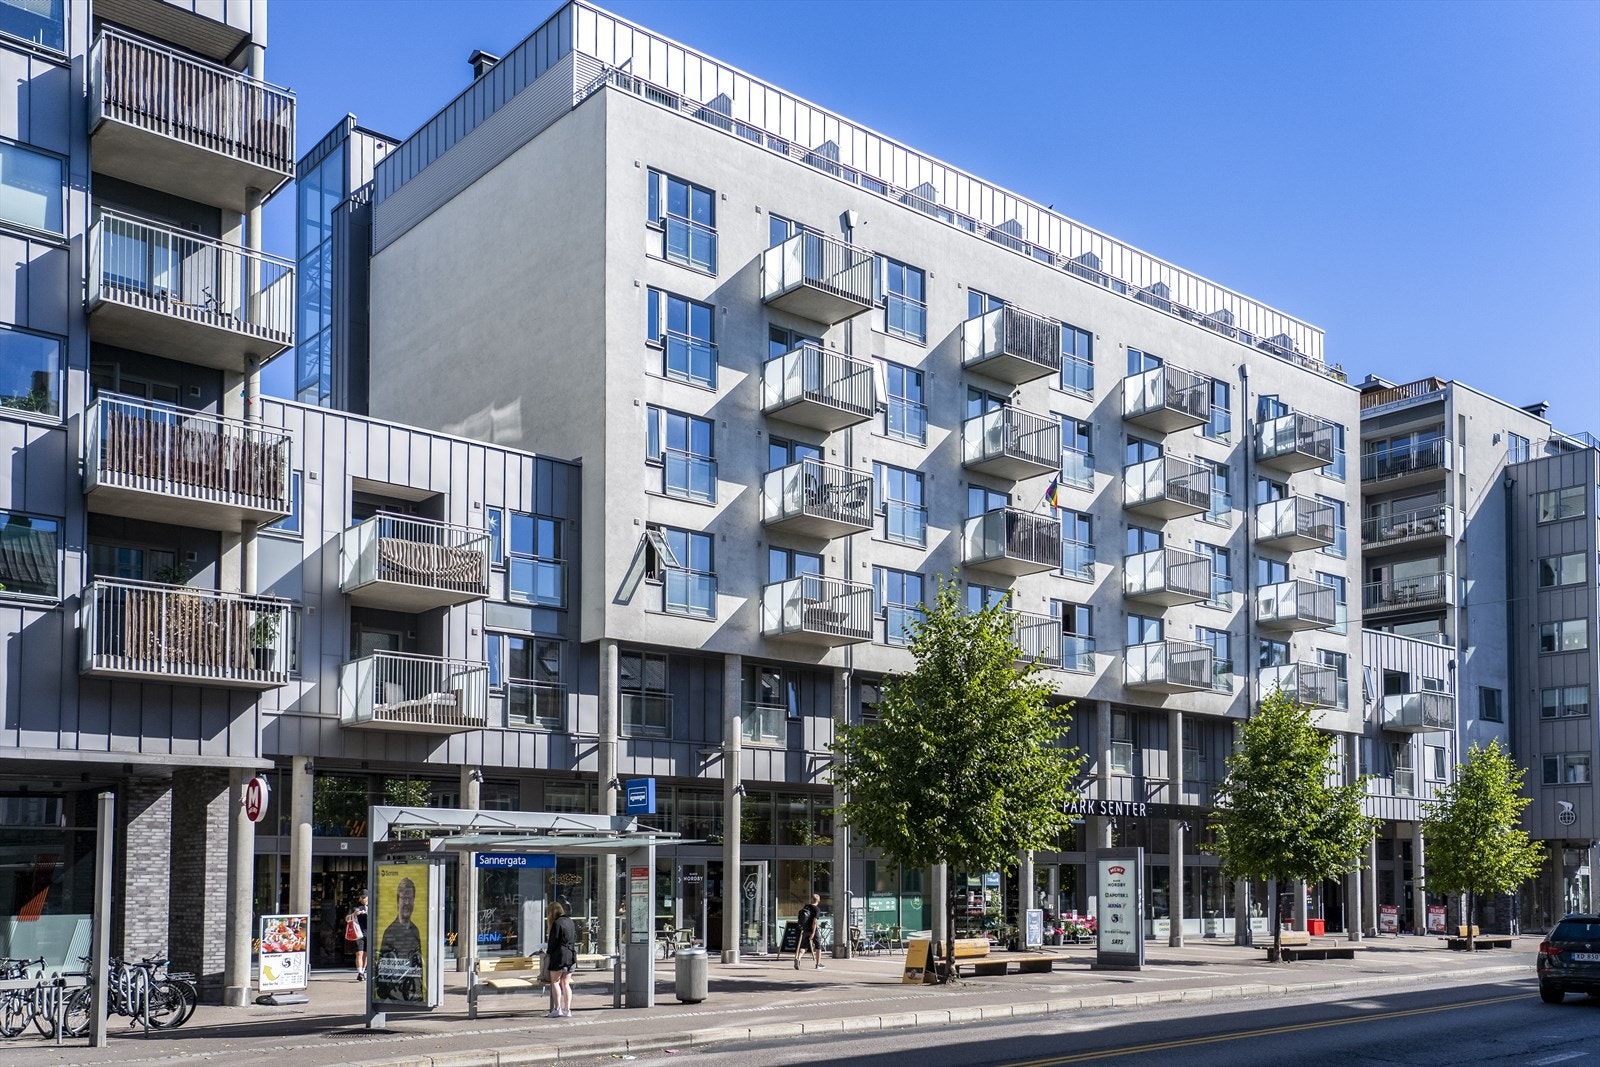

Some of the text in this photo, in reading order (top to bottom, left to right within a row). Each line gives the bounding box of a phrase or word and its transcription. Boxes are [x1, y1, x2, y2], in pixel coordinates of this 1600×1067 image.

[1063, 800, 1095, 815] PARK
[1100, 800, 1147, 817] SENTER
[479, 855, 527, 867] Sannergata
[1586, 953, 1600, 961] 850
